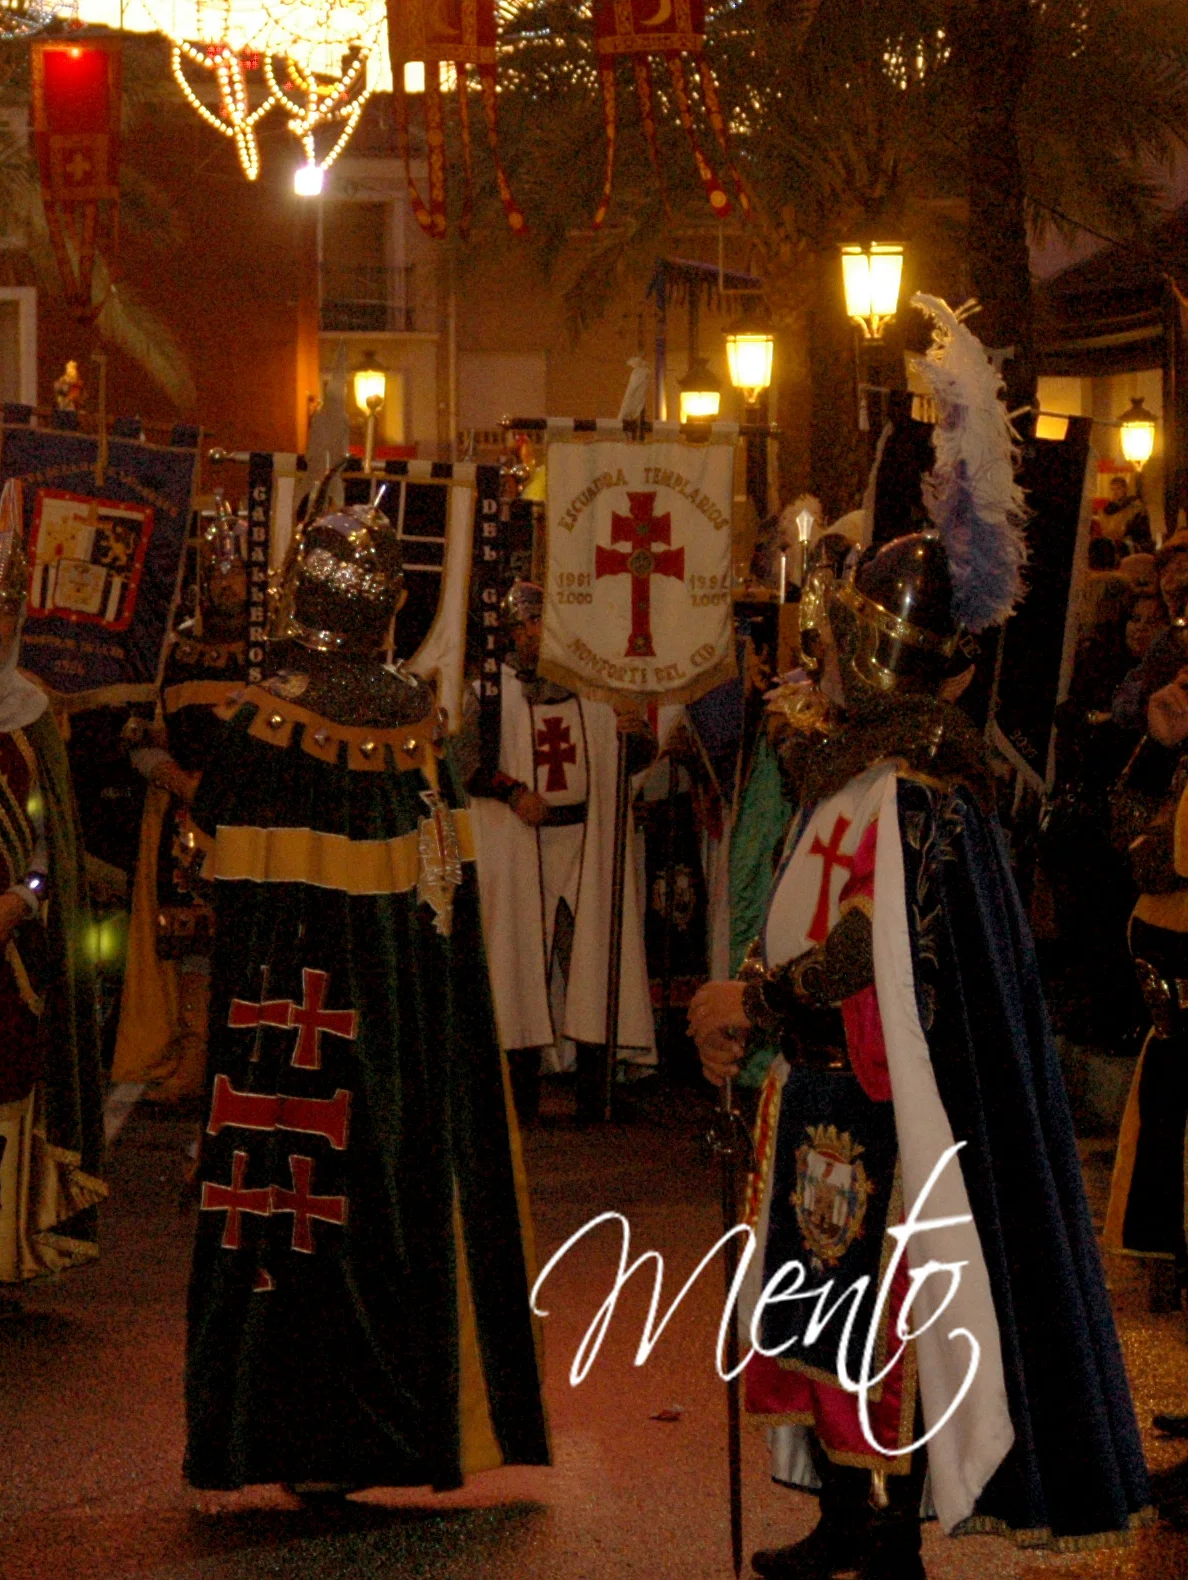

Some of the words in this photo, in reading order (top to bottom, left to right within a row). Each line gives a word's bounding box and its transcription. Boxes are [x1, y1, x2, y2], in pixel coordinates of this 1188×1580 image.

[558, 468, 629, 533] ESCUADRA
[644, 467, 730, 531] TEMPLARIOS
[655, 664, 687, 684] DEL
[690, 643, 717, 667] CID
